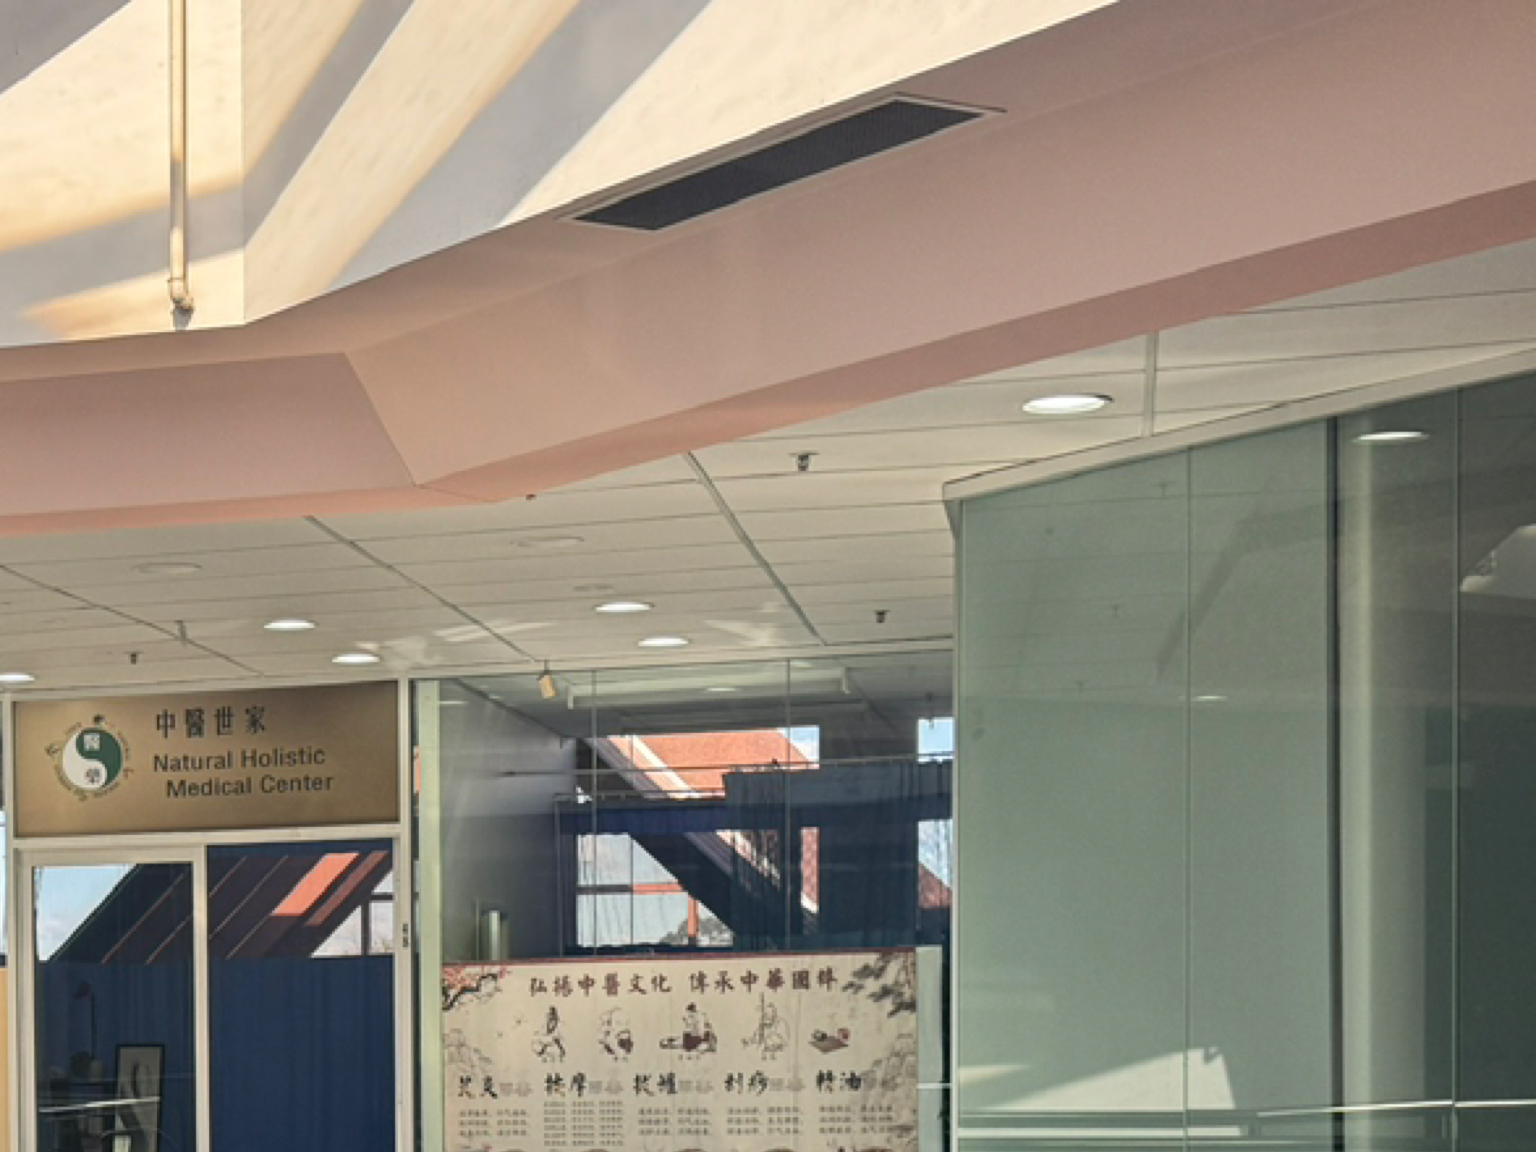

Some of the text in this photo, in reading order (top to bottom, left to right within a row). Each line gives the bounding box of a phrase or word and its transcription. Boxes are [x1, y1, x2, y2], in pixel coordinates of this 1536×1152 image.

[155, 705, 267, 739] 中醫世家
[153, 746, 326, 773] Natural Holistic
[167, 774, 334, 799] Medical Center
